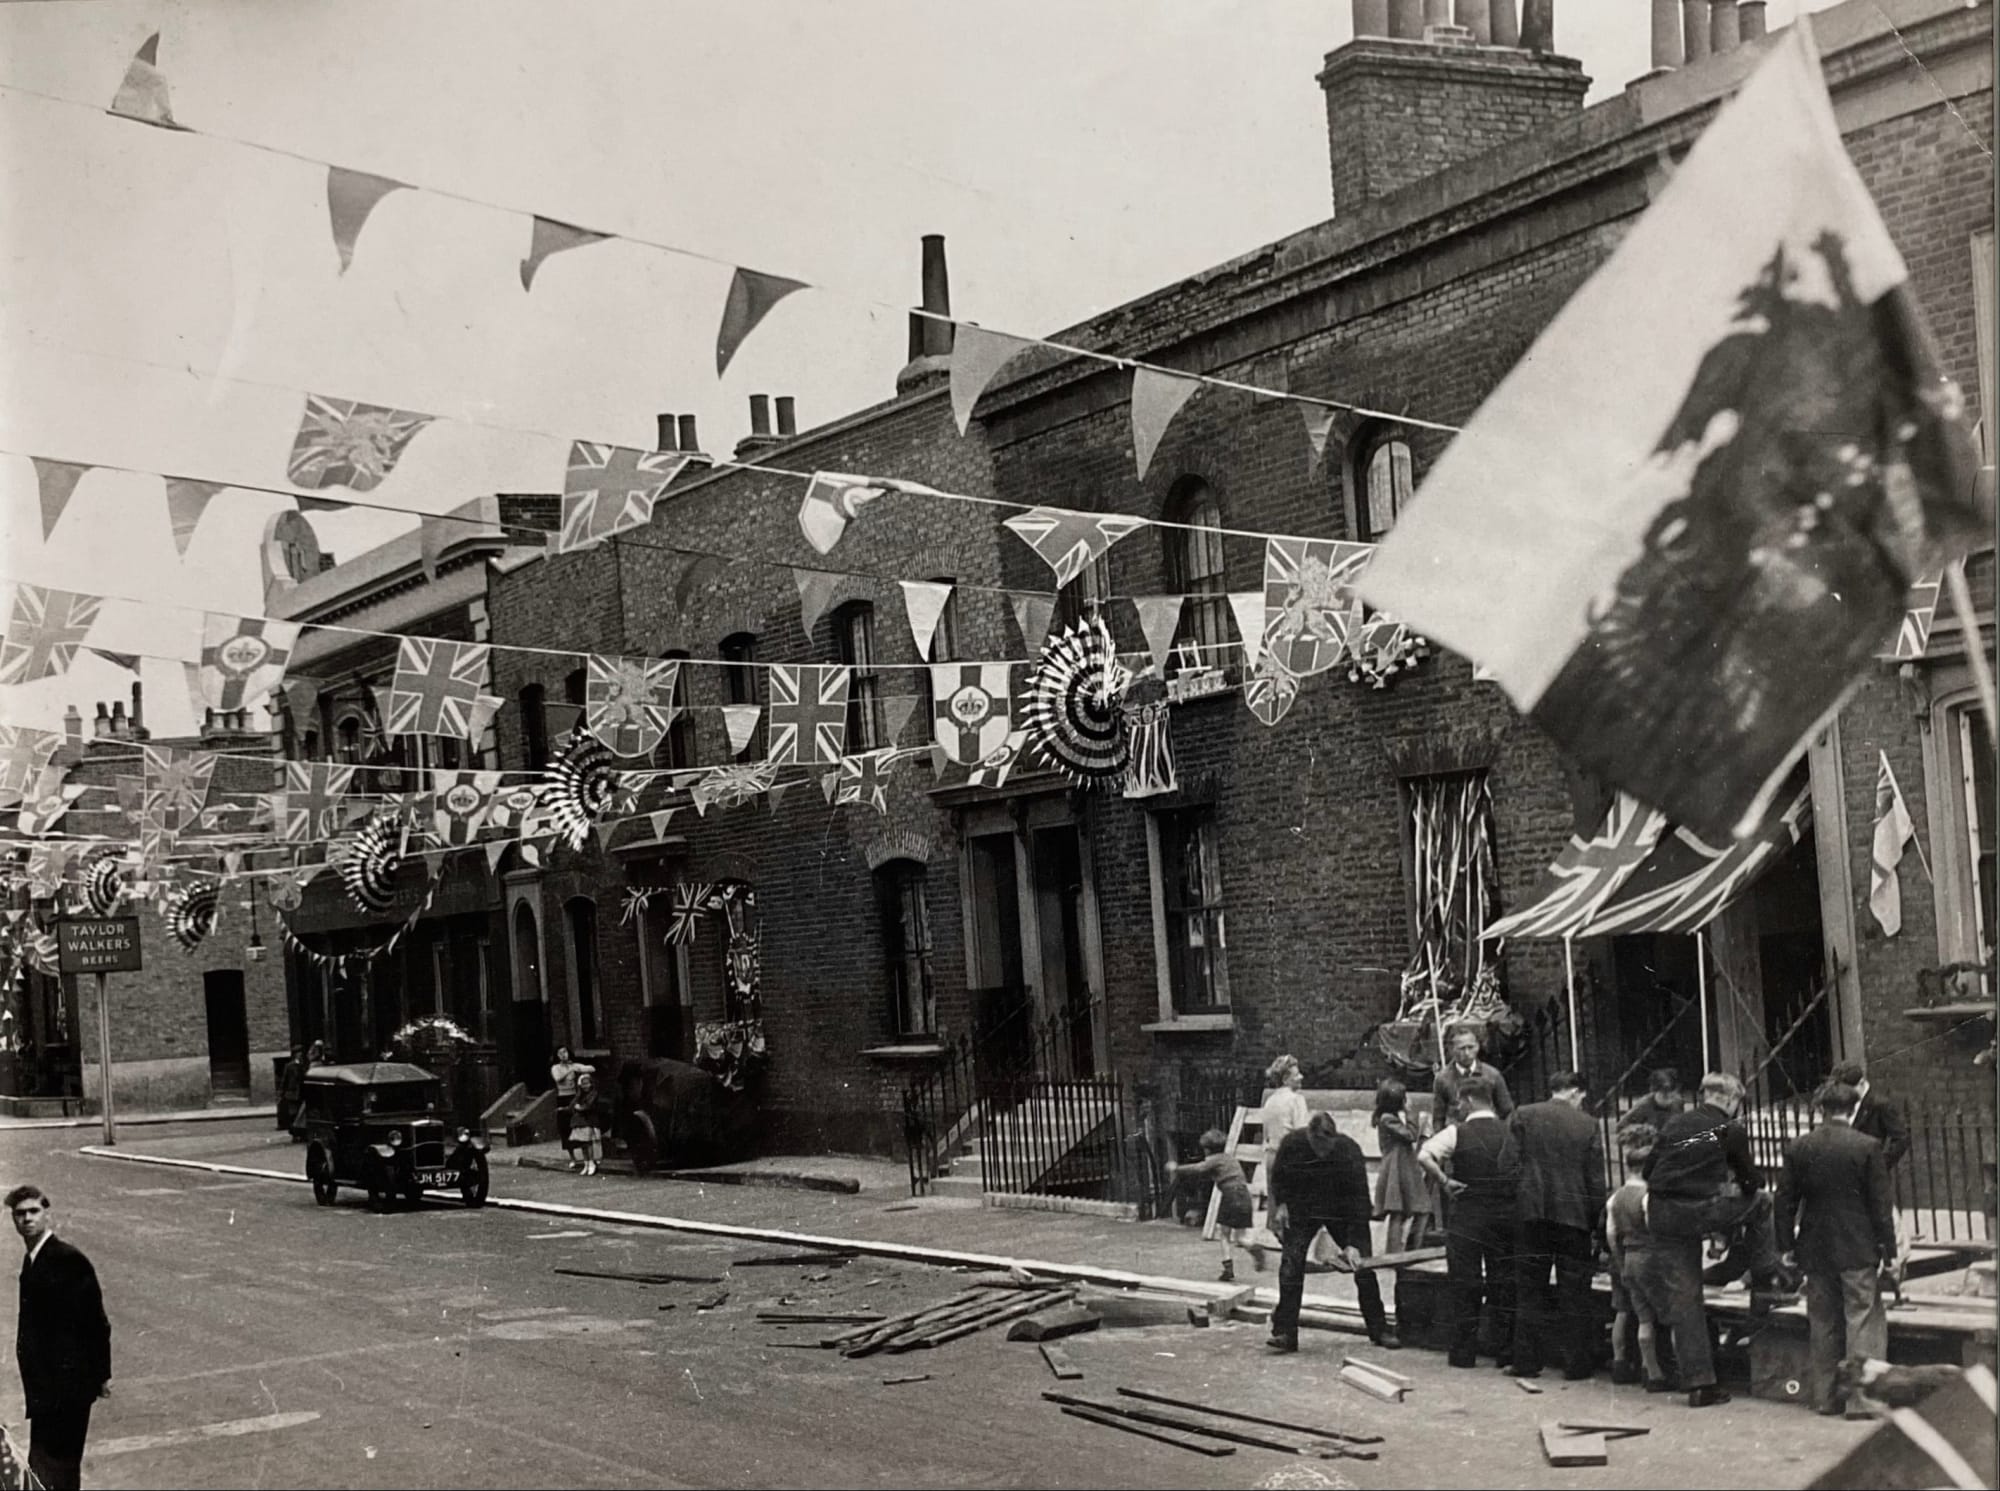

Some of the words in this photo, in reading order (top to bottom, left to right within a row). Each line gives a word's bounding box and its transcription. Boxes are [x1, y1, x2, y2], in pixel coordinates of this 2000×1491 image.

[70, 923, 125, 937] TAYLOR
[67, 938, 131, 952] WALKERS
[81, 955, 118, 965] BEERS
[435, 1171, 460, 1183] 5177
